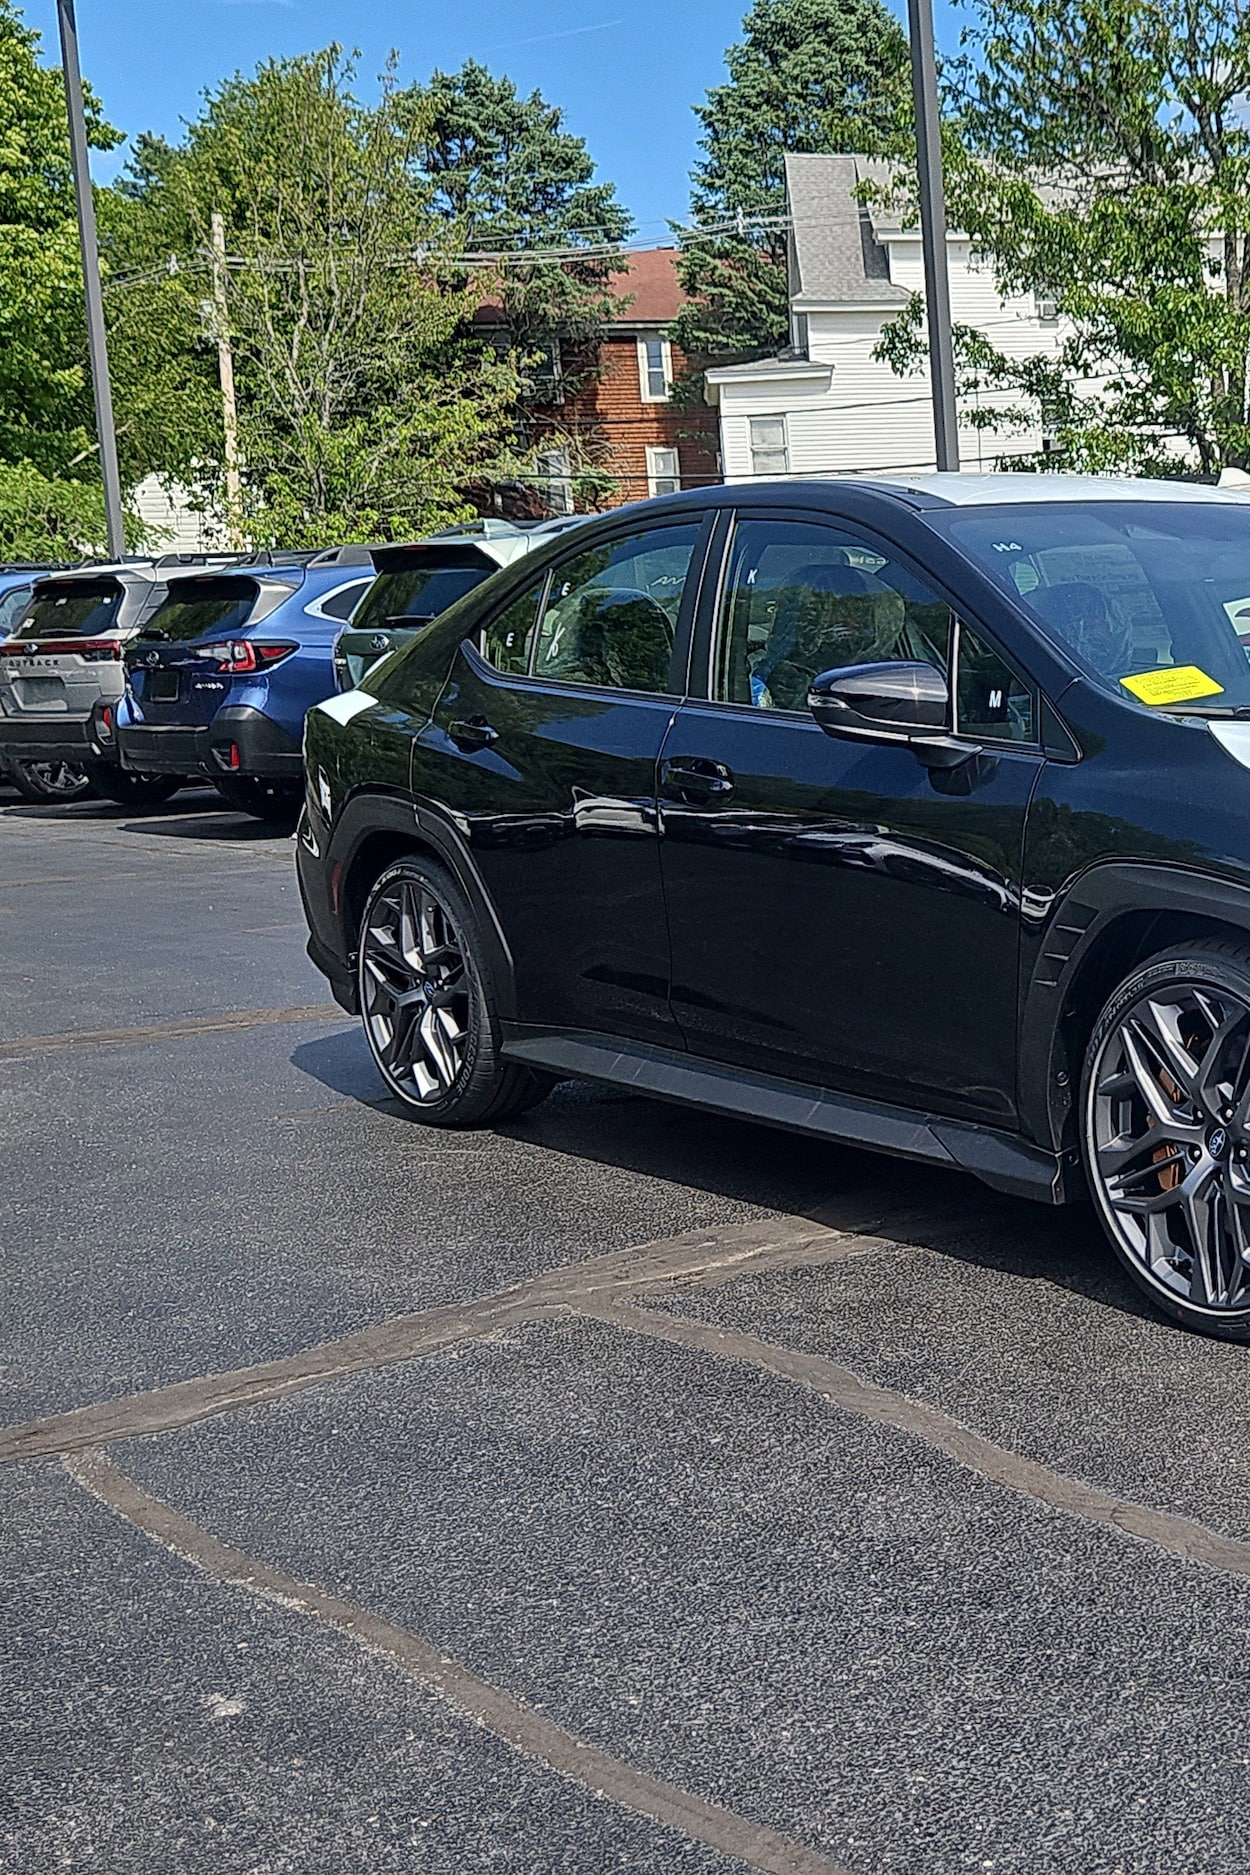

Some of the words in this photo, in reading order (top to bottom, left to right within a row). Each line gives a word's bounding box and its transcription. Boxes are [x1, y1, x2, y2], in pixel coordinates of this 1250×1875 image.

[561, 582, 571, 596] E
[506, 632, 515, 647] E
[989, 689, 1002, 708] M
